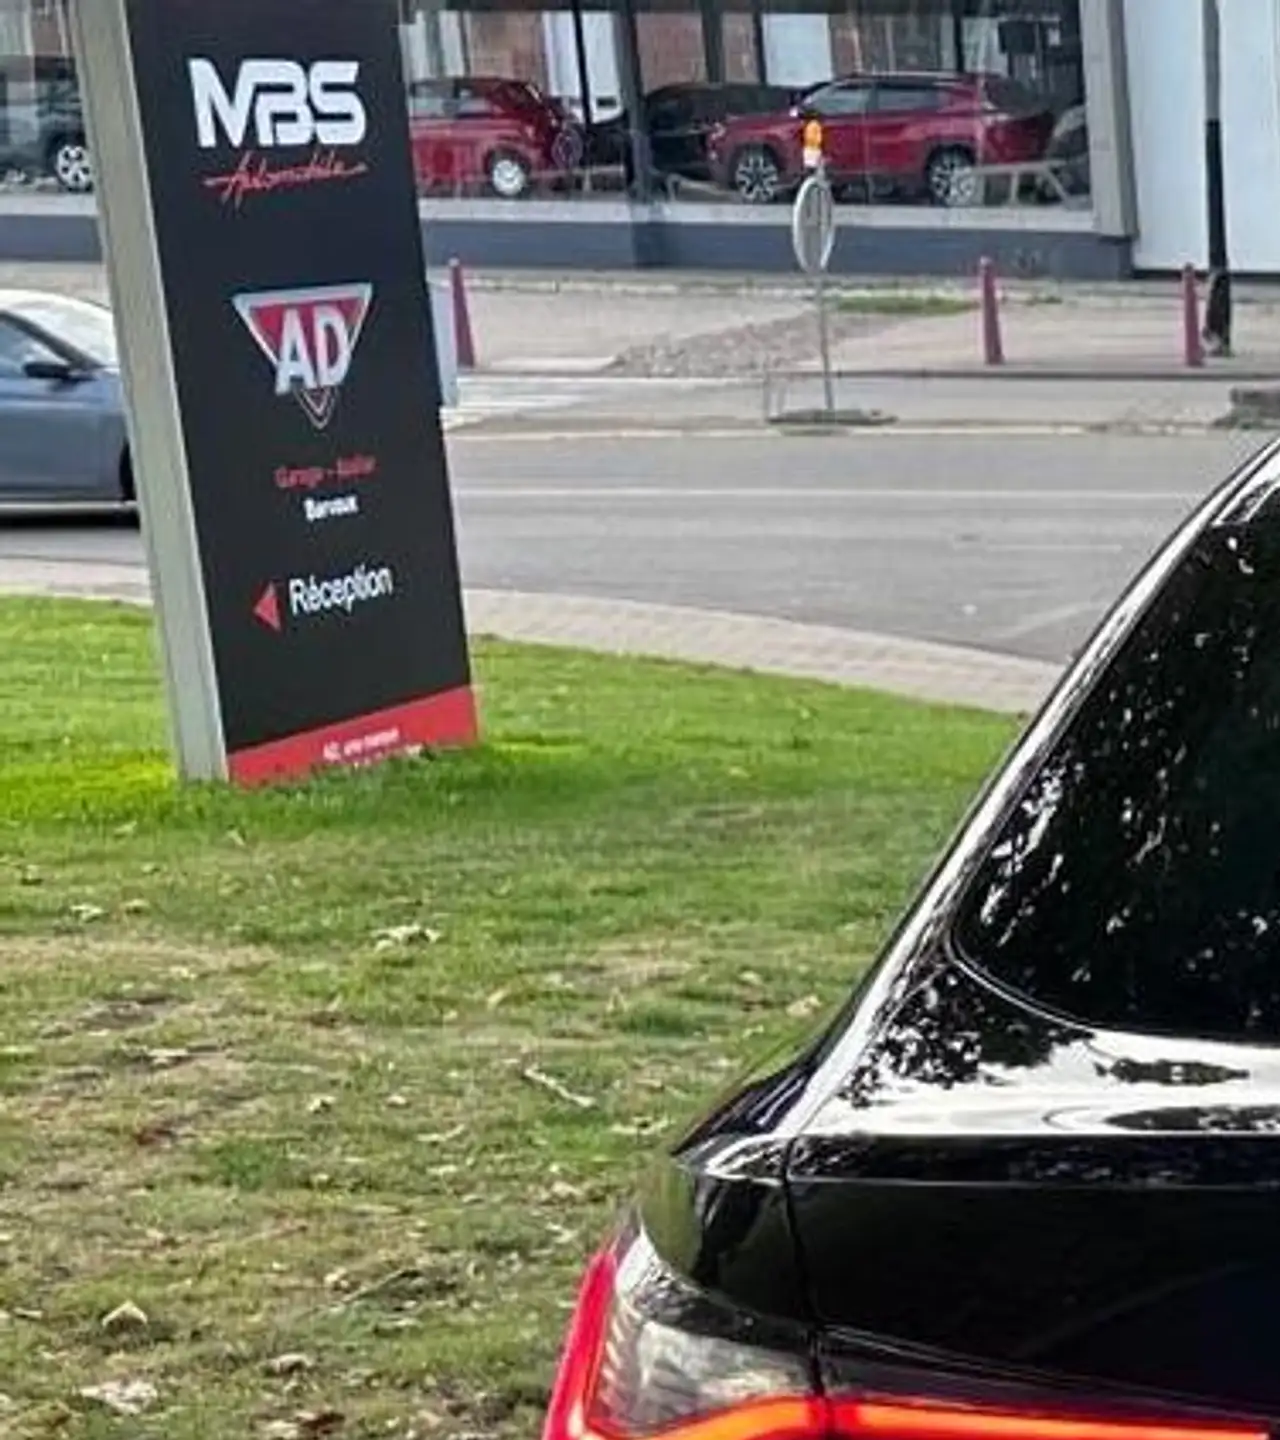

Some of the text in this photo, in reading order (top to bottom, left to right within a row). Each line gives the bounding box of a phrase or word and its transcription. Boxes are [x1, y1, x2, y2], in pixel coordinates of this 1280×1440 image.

[188, 58, 366, 147] MBS
[275, 303, 352, 396] AD
[289, 563, 393, 616] Réception
